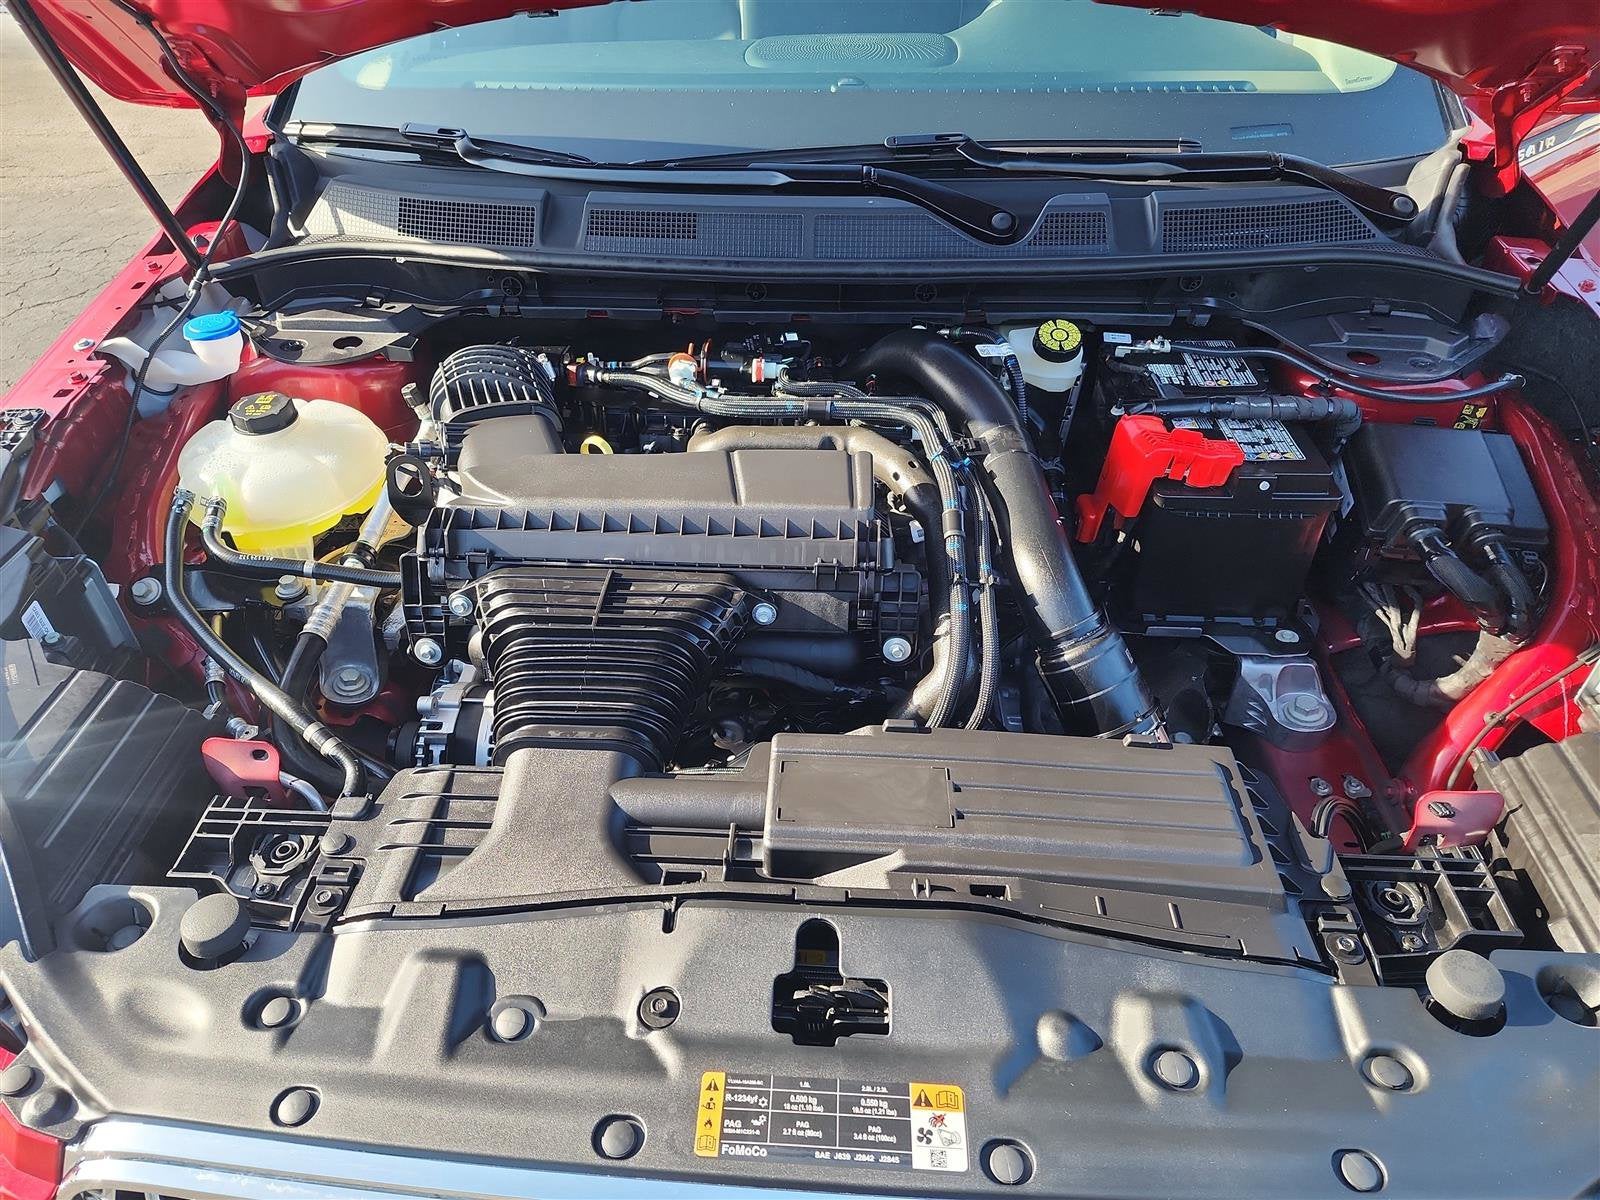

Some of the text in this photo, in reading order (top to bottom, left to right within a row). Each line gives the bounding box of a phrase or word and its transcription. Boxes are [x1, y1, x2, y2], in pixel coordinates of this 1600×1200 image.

[725, 1093, 759, 1104] R-1234yf
[724, 1119, 742, 1128] PAG
[721, 1143, 768, 1157] FoMoCo
[814, 1151, 831, 1160] SAE
